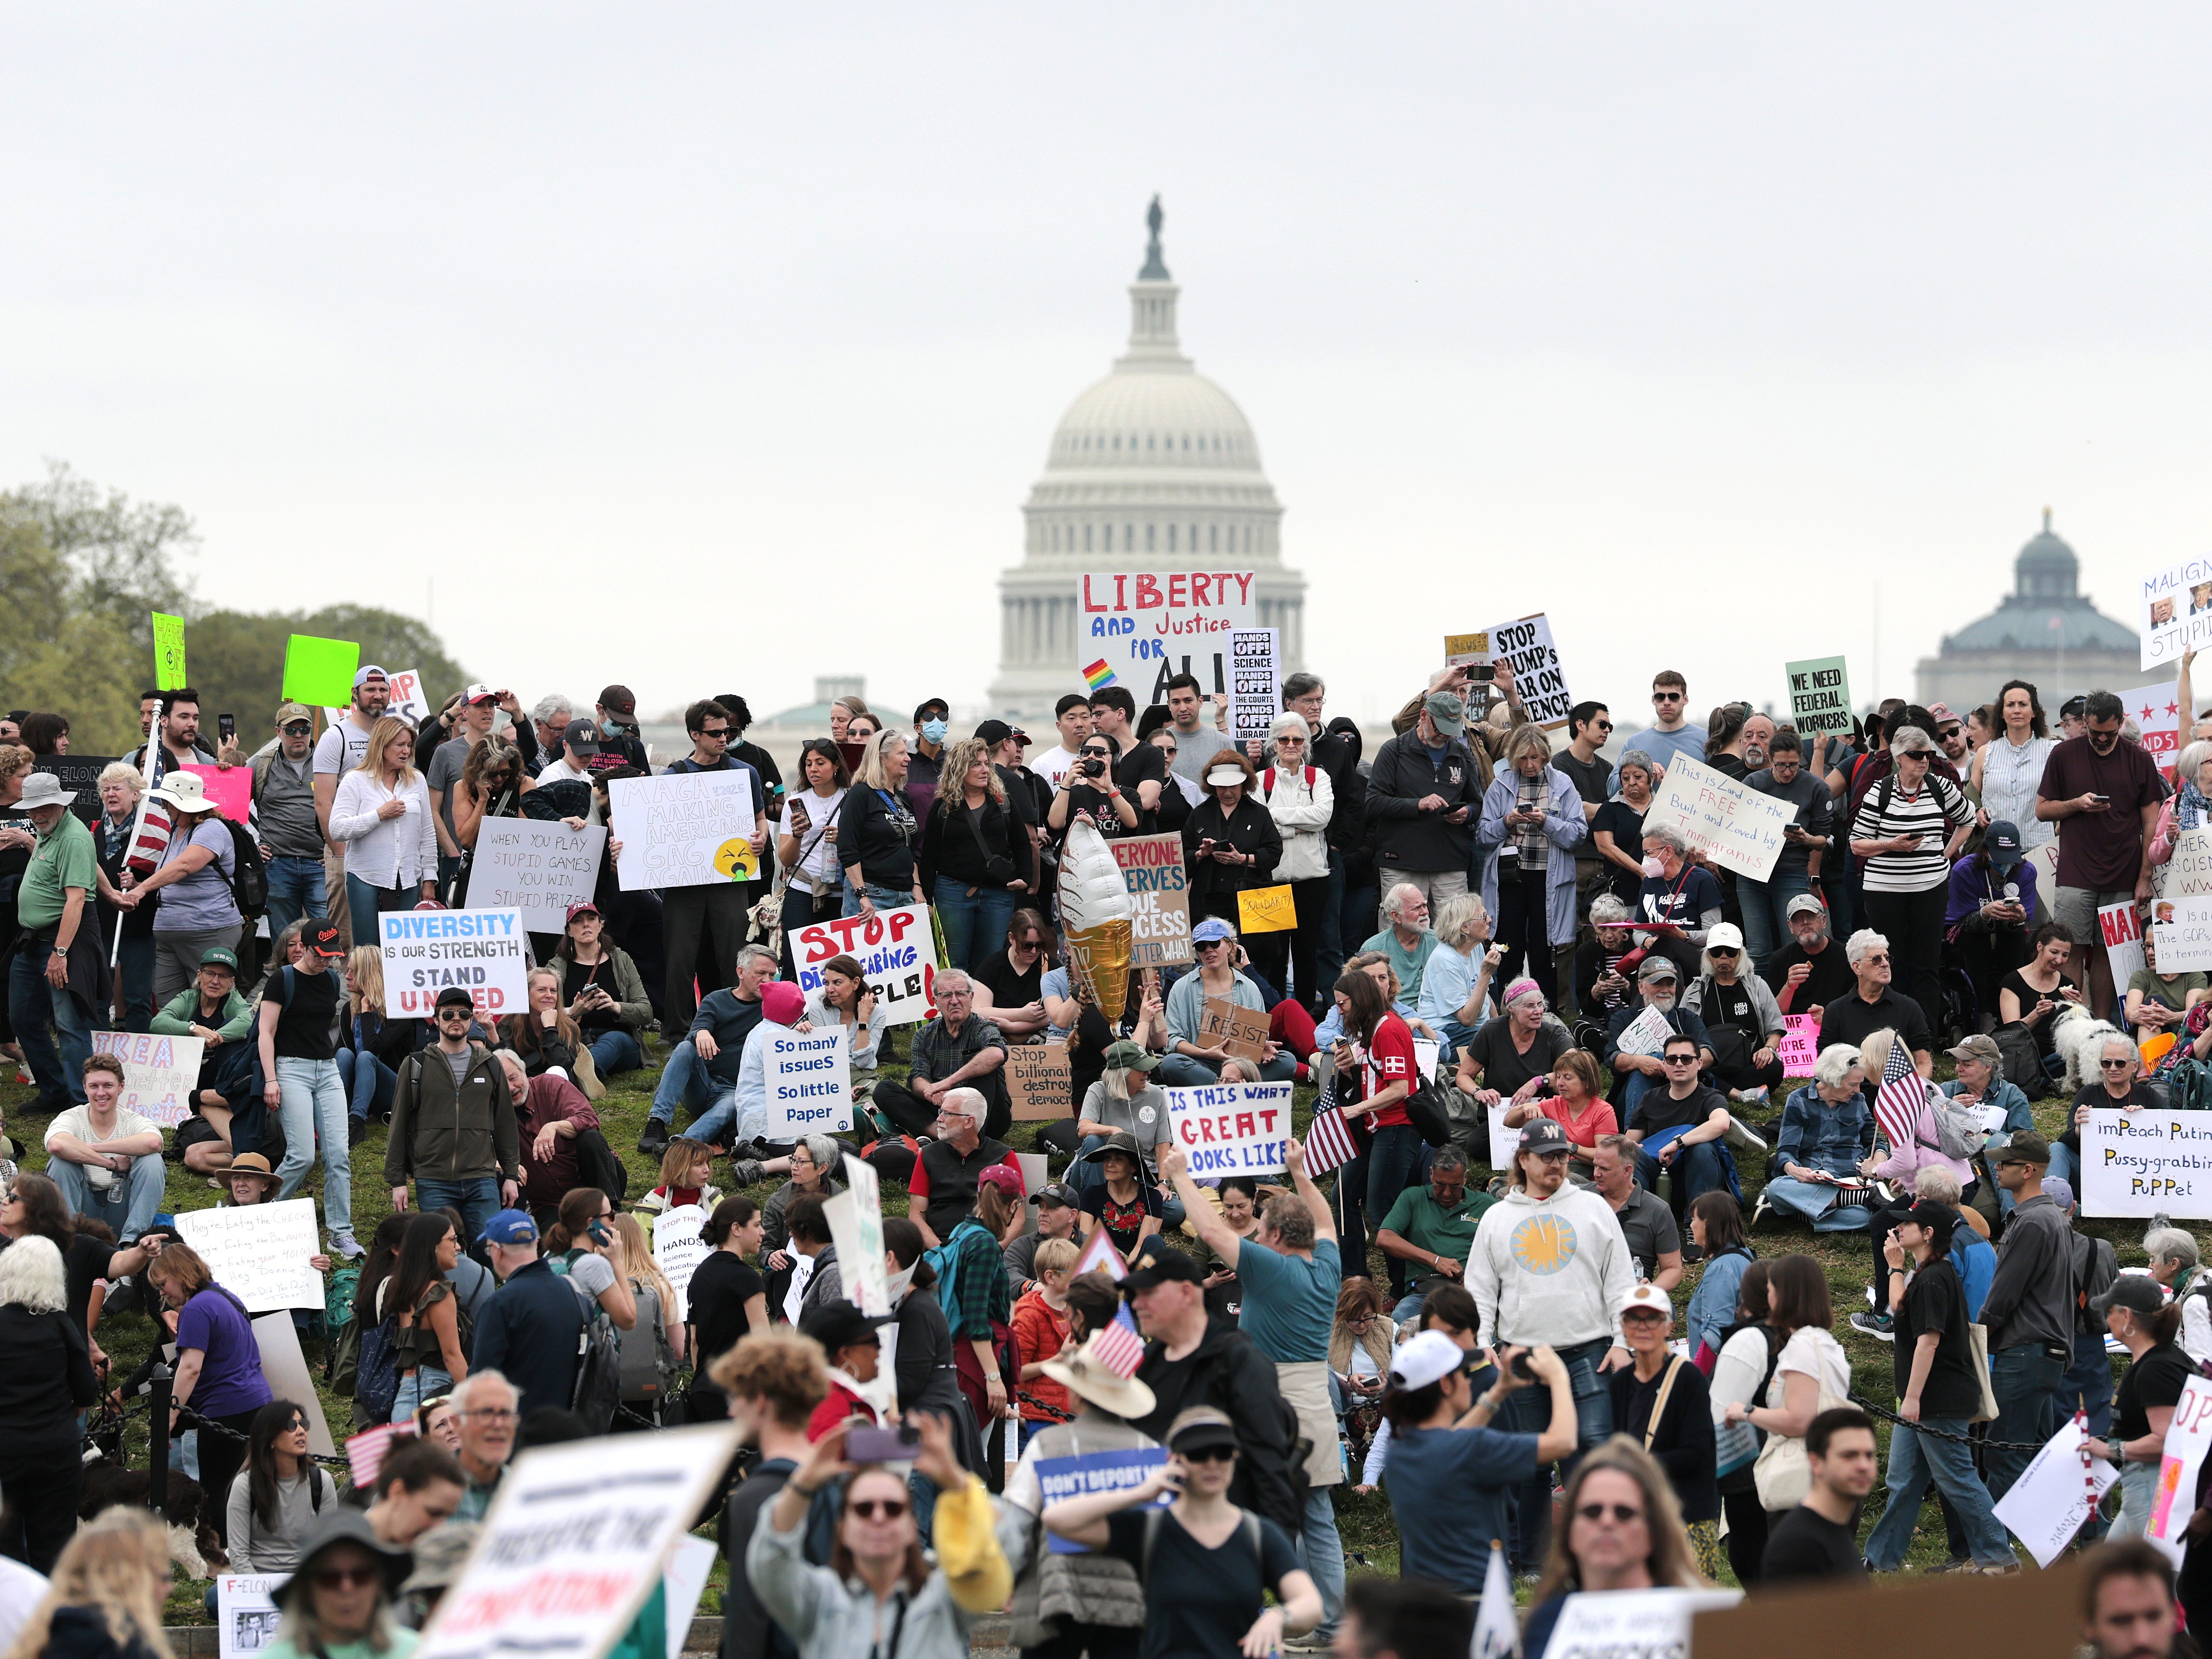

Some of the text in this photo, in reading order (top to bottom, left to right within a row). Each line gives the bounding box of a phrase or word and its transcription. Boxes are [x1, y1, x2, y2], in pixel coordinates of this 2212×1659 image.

[1084, 573, 1254, 612] LIBERTY
[1156, 612, 1231, 635] Justice
[1497, 623, 1535, 653] STOP
[1236, 642, 1270, 655] OFF!
[1234, 658, 1272, 668] SCIENCE
[1237, 680, 1271, 693] OFF!
[1516, 667, 1563, 699] AR ON
[1791, 669, 1841, 691] WE NEED
[1794, 691, 1843, 713] FEDERAL
[1795, 711, 1848, 734] WORKERS
[580, 730, 593, 741] W
[59, 767, 101, 782] ELON
[622, 774, 709, 807] MAGA
[1676, 757, 1784, 818] This is Land of the
[647, 797, 736, 825] MAKING
[1699, 788, 1737, 815] FREE
[646, 814, 753, 844] AMERICANS
[1098, 820, 1120, 831] RCH
[1670, 794, 1776, 850] Built and Loved by
[491, 834, 588, 852] WHEN YOU PLAY
[494, 852, 541, 867] STUPID
[643, 842, 704, 869] GAG
[518, 872, 573, 886] YOU WIN
[643, 864, 714, 888] AGAIN
[493, 890, 541, 908] STUPID
[1243, 892, 1292, 911] SOLIDARITY
[2187, 910, 2208, 921] is a
[386, 914, 515, 939] DIVERSITY
[2155, 928, 2210, 943] The GOP's
[800, 912, 914, 963] STOP
[385, 940, 519, 959] IS OUR STRENGTH
[1130, 937, 1190, 965] ATTER WHAT
[2161, 951, 2170, 960] is
[413, 966, 486, 987] STAND
[401, 987, 504, 1012] UNED
[1209, 1015, 1267, 1044] RESIST
[94, 1033, 174, 1069] IKEA
[775, 1040, 795, 1053] So
[1011, 1047, 1046, 1065] Stop
[778, 1081, 839, 1099] So little
[1169, 1087, 1290, 1111] IS THIS WHAT
[1181, 1109, 1278, 1145] GREAT
[1542, 1125, 1559, 1139] W
[1243, 1141, 1287, 1167] LIKE
[180, 1209, 312, 1236] They're Eating the CHECKS
[662, 1218, 681, 1230] STOP
[225, 1239, 252, 1249] Eating
[270, 1232, 313, 1243] BALANCES
[663, 1238, 702, 1253] HANDS
[228, 1257, 255, 1268] Eating
[663, 1253, 693, 1263] Science
[300, 1266, 312, 1276] J
[258, 1284, 273, 1295] Did
[276, 1282, 287, 1292] You
[1042, 1470, 1086, 1495] DON'T
[1088, 1465, 1143, 1490] DEPORT
[227, 1580, 271, 1593] F-ELON
